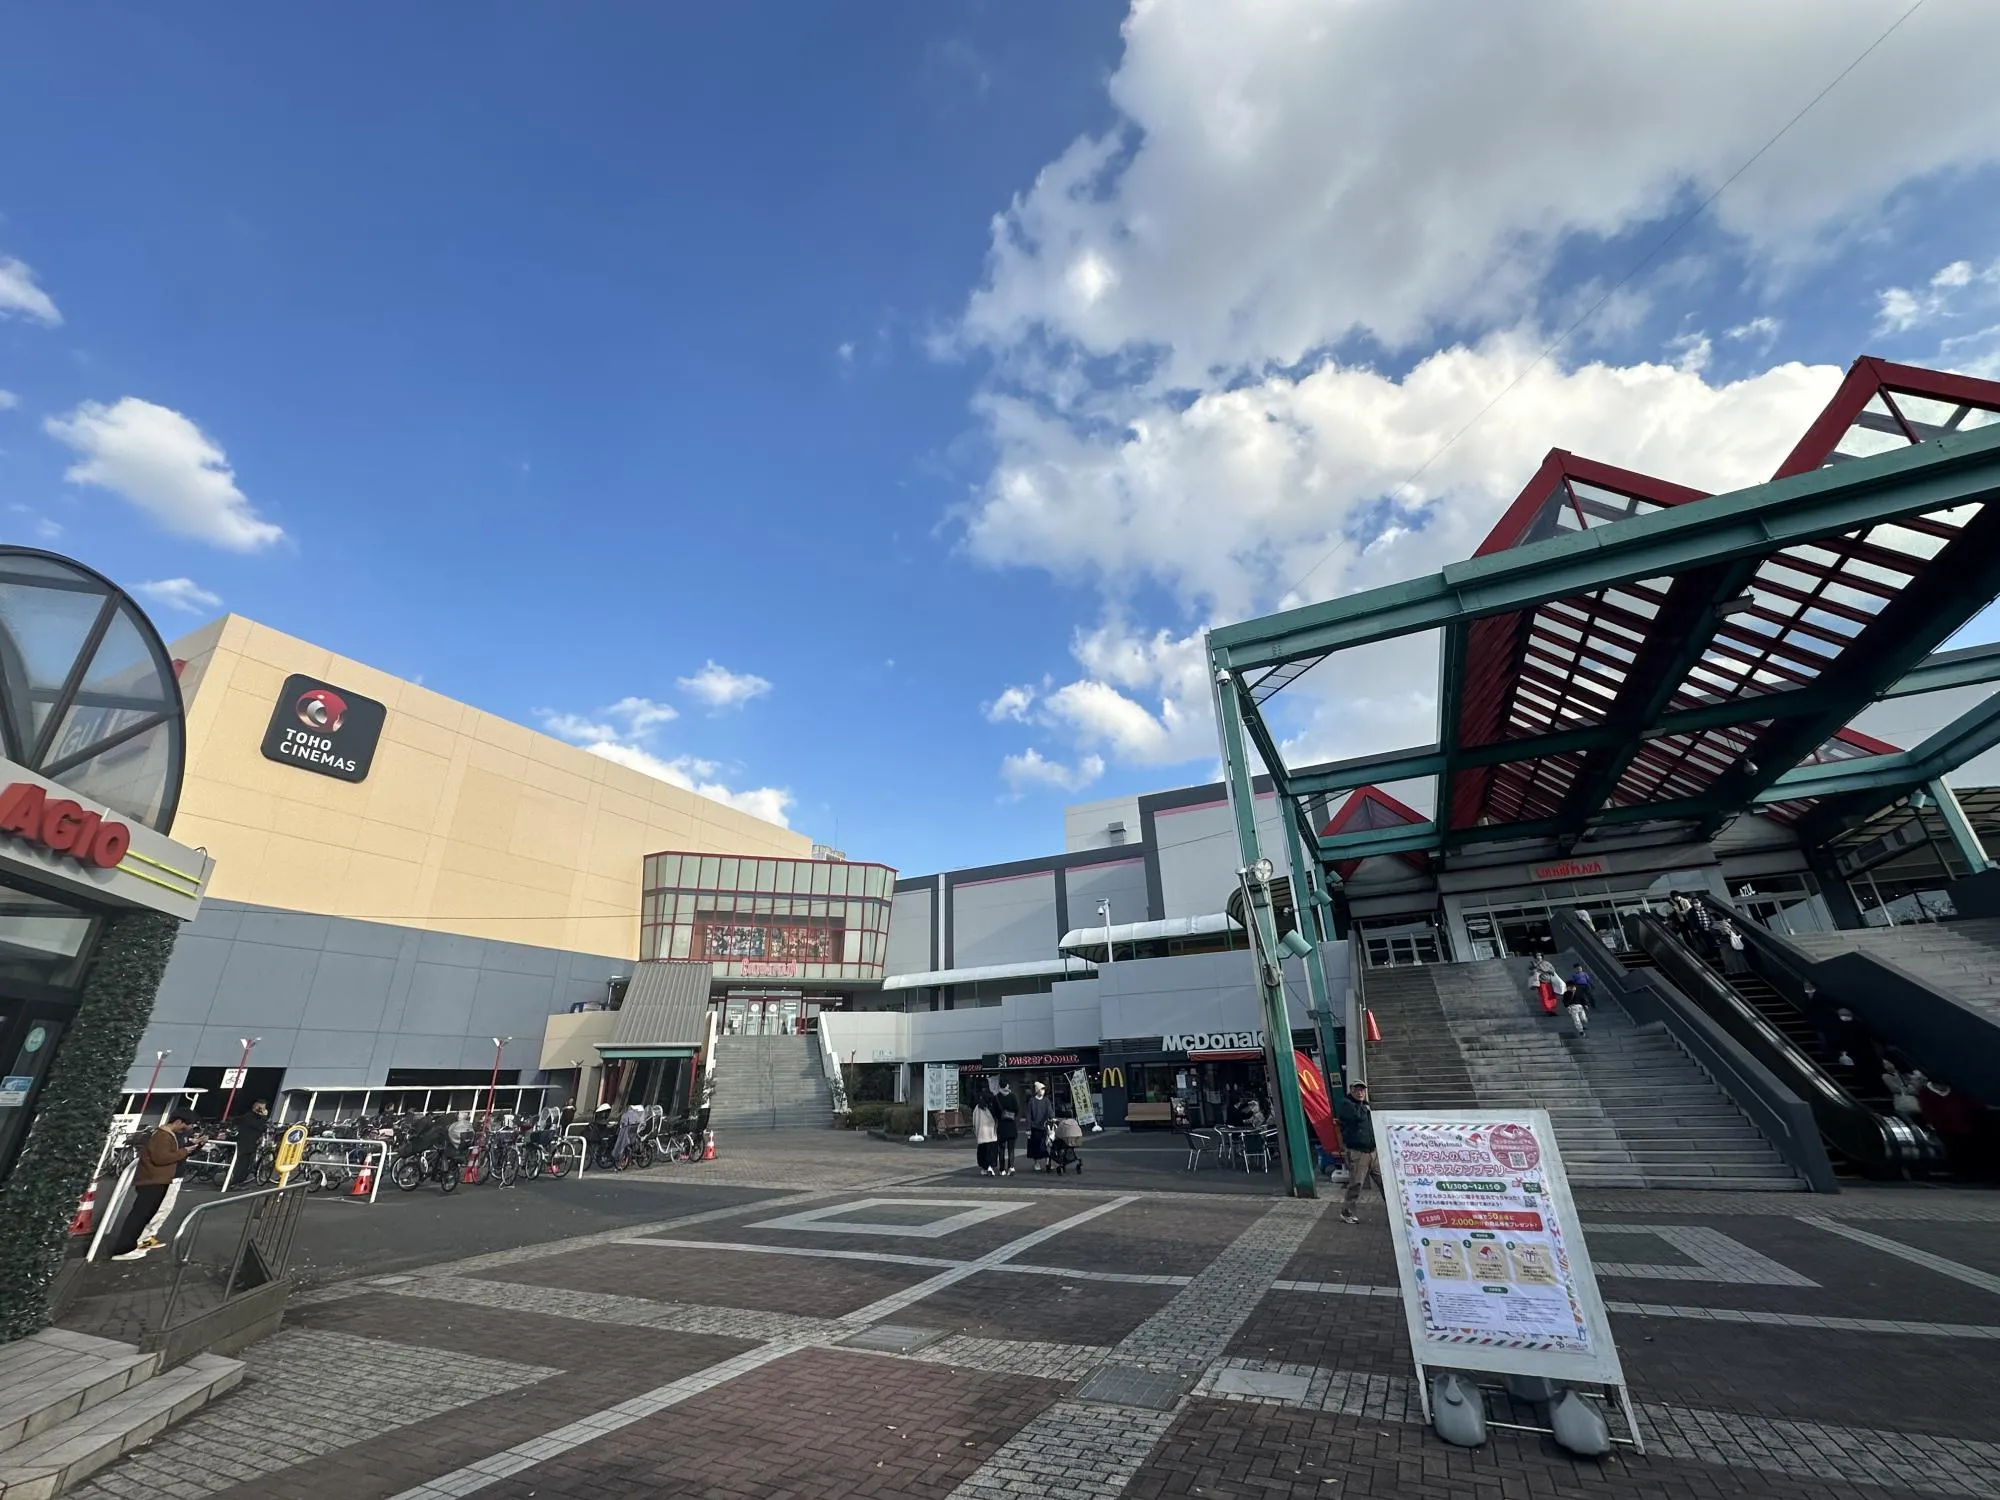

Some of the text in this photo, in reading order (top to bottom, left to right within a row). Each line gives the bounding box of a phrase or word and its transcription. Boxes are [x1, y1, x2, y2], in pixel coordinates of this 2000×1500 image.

[286, 728, 332, 751] TOHO
[280, 741, 356, 772] CINEMAS
[0, 783, 131, 869] AGIO
